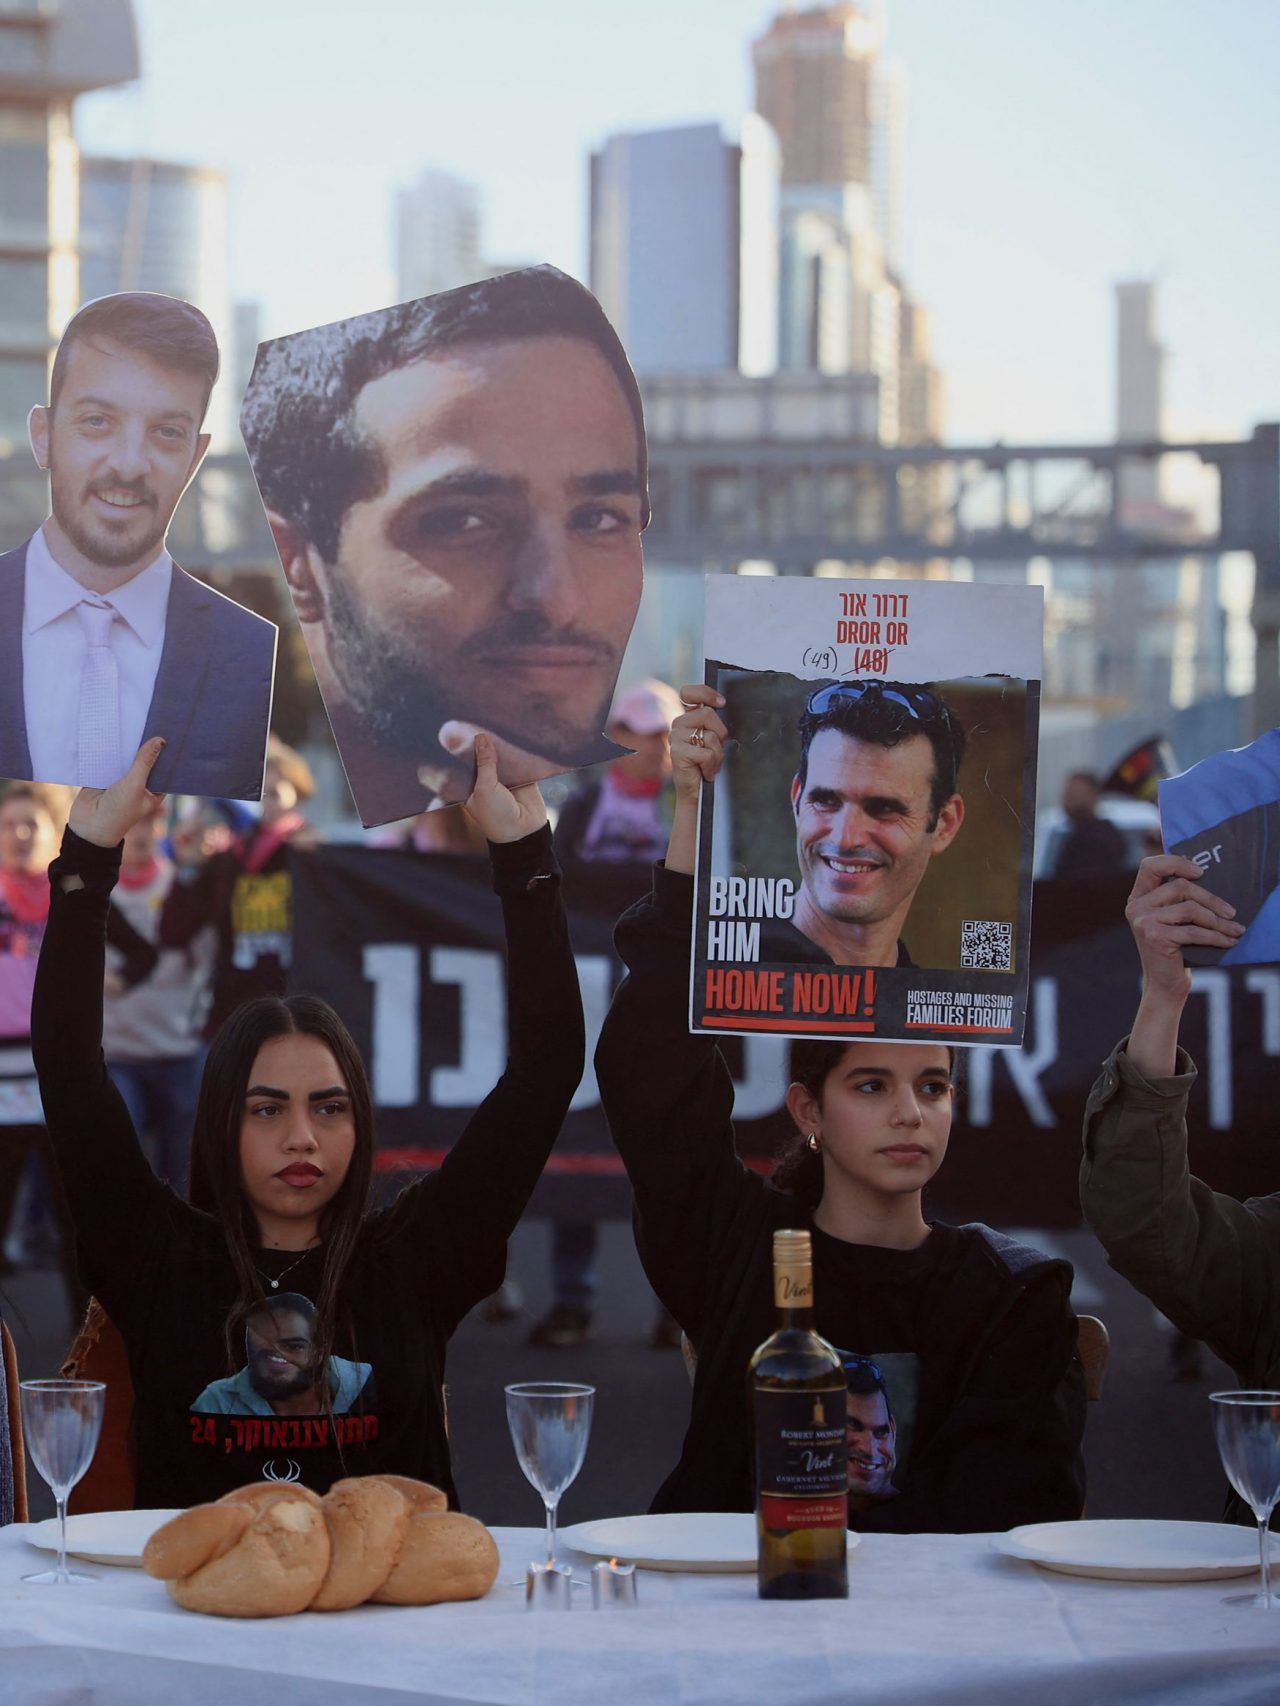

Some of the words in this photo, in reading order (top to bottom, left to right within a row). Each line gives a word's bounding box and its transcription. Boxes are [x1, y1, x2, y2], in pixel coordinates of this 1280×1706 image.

[839, 592, 867, 617] אור
[872, 594, 909, 618] דרור
[836, 620, 881, 645] DROR
[886, 621, 908, 645] OR
[802, 646, 838, 673] (49)
[854, 647, 888, 675] (48)
[709, 875, 795, 919] BRING
[707, 920, 760, 962] HIM
[705, 968, 785, 1012] HOME
[792, 969, 876, 1016] NOW!
[907, 990, 953, 1006] HOSTAGES
[953, 992, 972, 1007] AND
[973, 993, 1013, 1009] MISSING
[906, 1004, 964, 1025] FAMILIES
[967, 1007, 1012, 1029] FORUM
